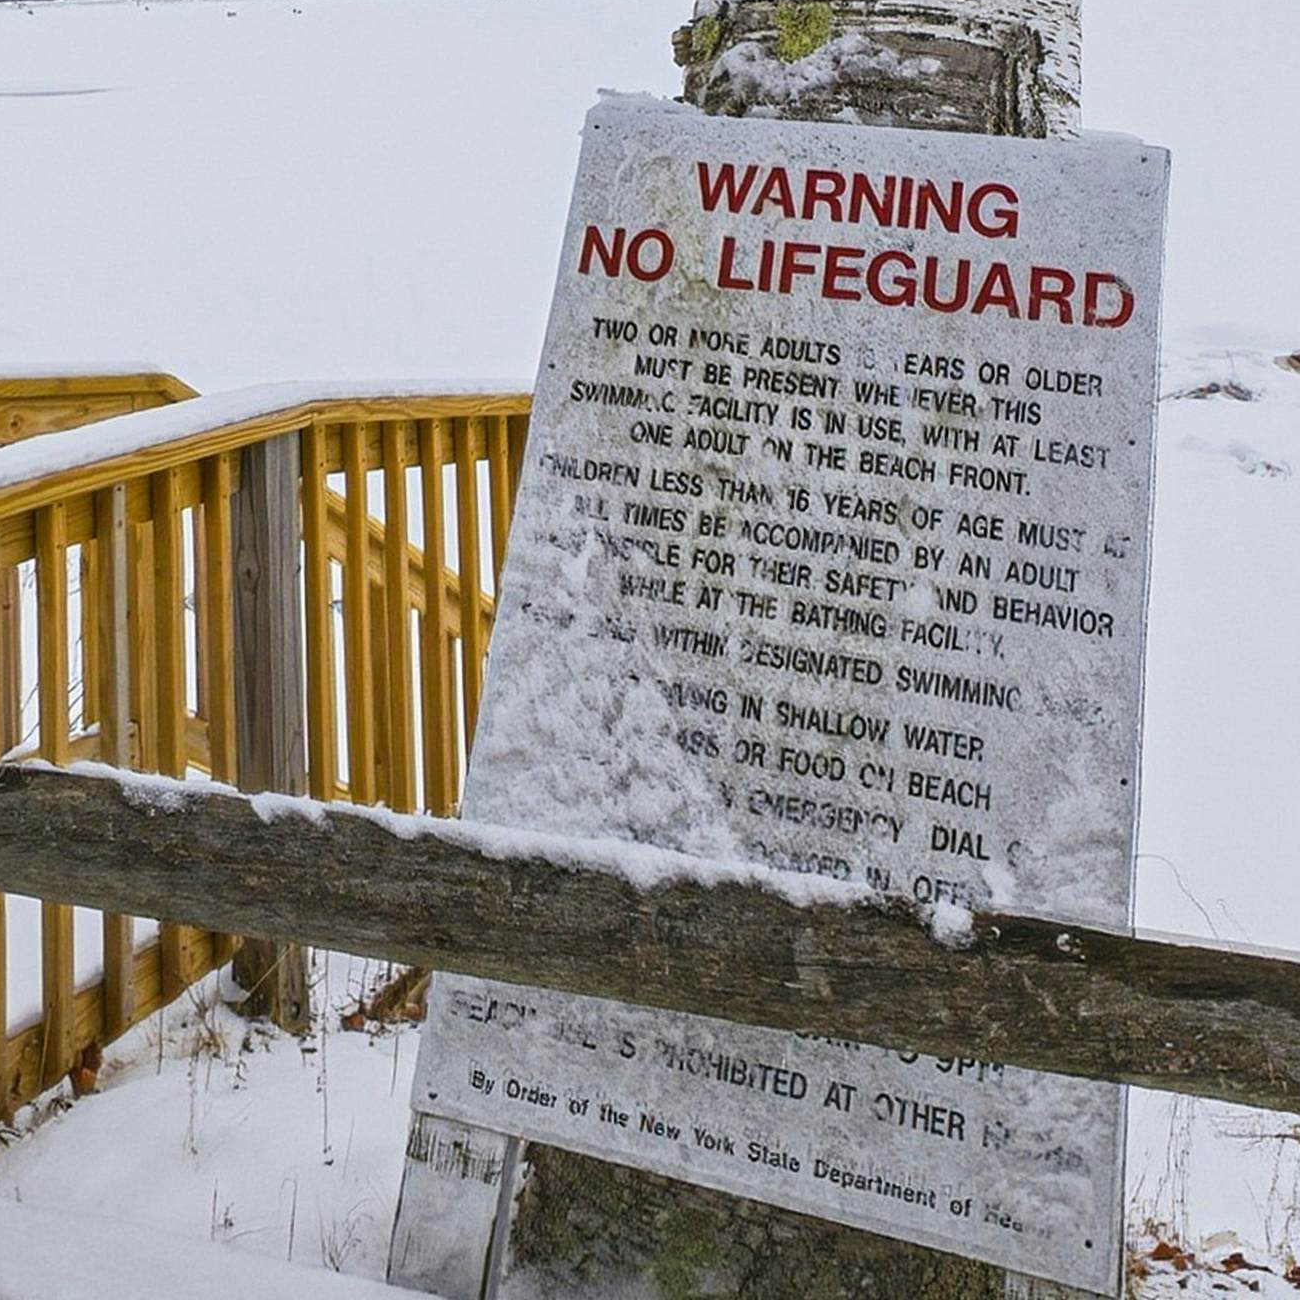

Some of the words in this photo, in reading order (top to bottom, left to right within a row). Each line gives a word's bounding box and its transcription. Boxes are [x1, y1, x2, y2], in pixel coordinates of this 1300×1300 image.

[697, 161, 1020, 239] WARNING
[578, 225, 676, 282] NO
[717, 236, 1136, 330] LIFEGUARD
[593, 317, 638, 343] TWO
[650, 324, 678, 348] OR
[689, 329, 750, 357] MORE
[760, 336, 842, 366] ADULTS
[893, 353, 966, 381] EARS
[979, 362, 1010, 386] OR
[1025, 367, 1103, 397] OLDER
[634, 354, 693, 381] MUST
[703, 362, 733, 386] BE
[743, 367, 842, 399] PRESENT
[991, 397, 1042, 426] THIS
[630, 420, 674, 448] ONE
[683, 428, 751, 456] ADULT
[805, 443, 847, 472] THE
[859, 450, 936, 483] BEACH
[949, 463, 1031, 497] FRONT.
[791, 406, 813, 431] IS
[824, 411, 846, 436] IN
[857, 415, 907, 448] USE,
[922, 423, 980, 452] WITH
[992, 434, 1020, 459] AT
[1033, 438, 1111, 470] LEAST
[650, 467, 705, 498] LESS
[718, 477, 775, 507] THAN
[787, 488, 810, 513] 16
[823, 493, 899, 526] YEARS
[911, 505, 944, 531] OF
[956, 512, 1004, 541] AGE
[1018, 521, 1088, 553] MUST
[700, 510, 727, 538] BE
[914, 546, 945, 572] BY
[958, 553, 991, 580] AN
[1004, 560, 1081, 594] ADULT
[619, 573, 687, 607] WHILE
[696, 586, 724, 612] AT
[735, 590, 779, 620] THE
[791, 599, 888, 639] BATHING
[691, 550, 736, 578] FOR
[748, 555, 813, 589] THEIR
[993, 595, 1115, 638] BEHAVIOR
[740, 691, 764, 722] IN
[777, 700, 891, 743] SHALLOW
[903, 724, 985, 762] WATER
[734, 738, 767, 768] OR
[779, 747, 847, 781] FOOD
[907, 771, 992, 812] BEACH
[931, 823, 991, 861] DIAL
[471, 1069, 496, 1096] By
[505, 1078, 558, 1109] Order
[568, 1098, 590, 1117] of
[599, 1103, 630, 1128] the
[639, 1113, 682, 1142] New
[694, 1128, 737, 1157] York
[748, 1141, 801, 1173] State
[812, 1158, 938, 1209] Department
[949, 1197, 974, 1218] of
[823, 1081, 858, 1113] AT
[872, 1092, 966, 1142] OTHER
